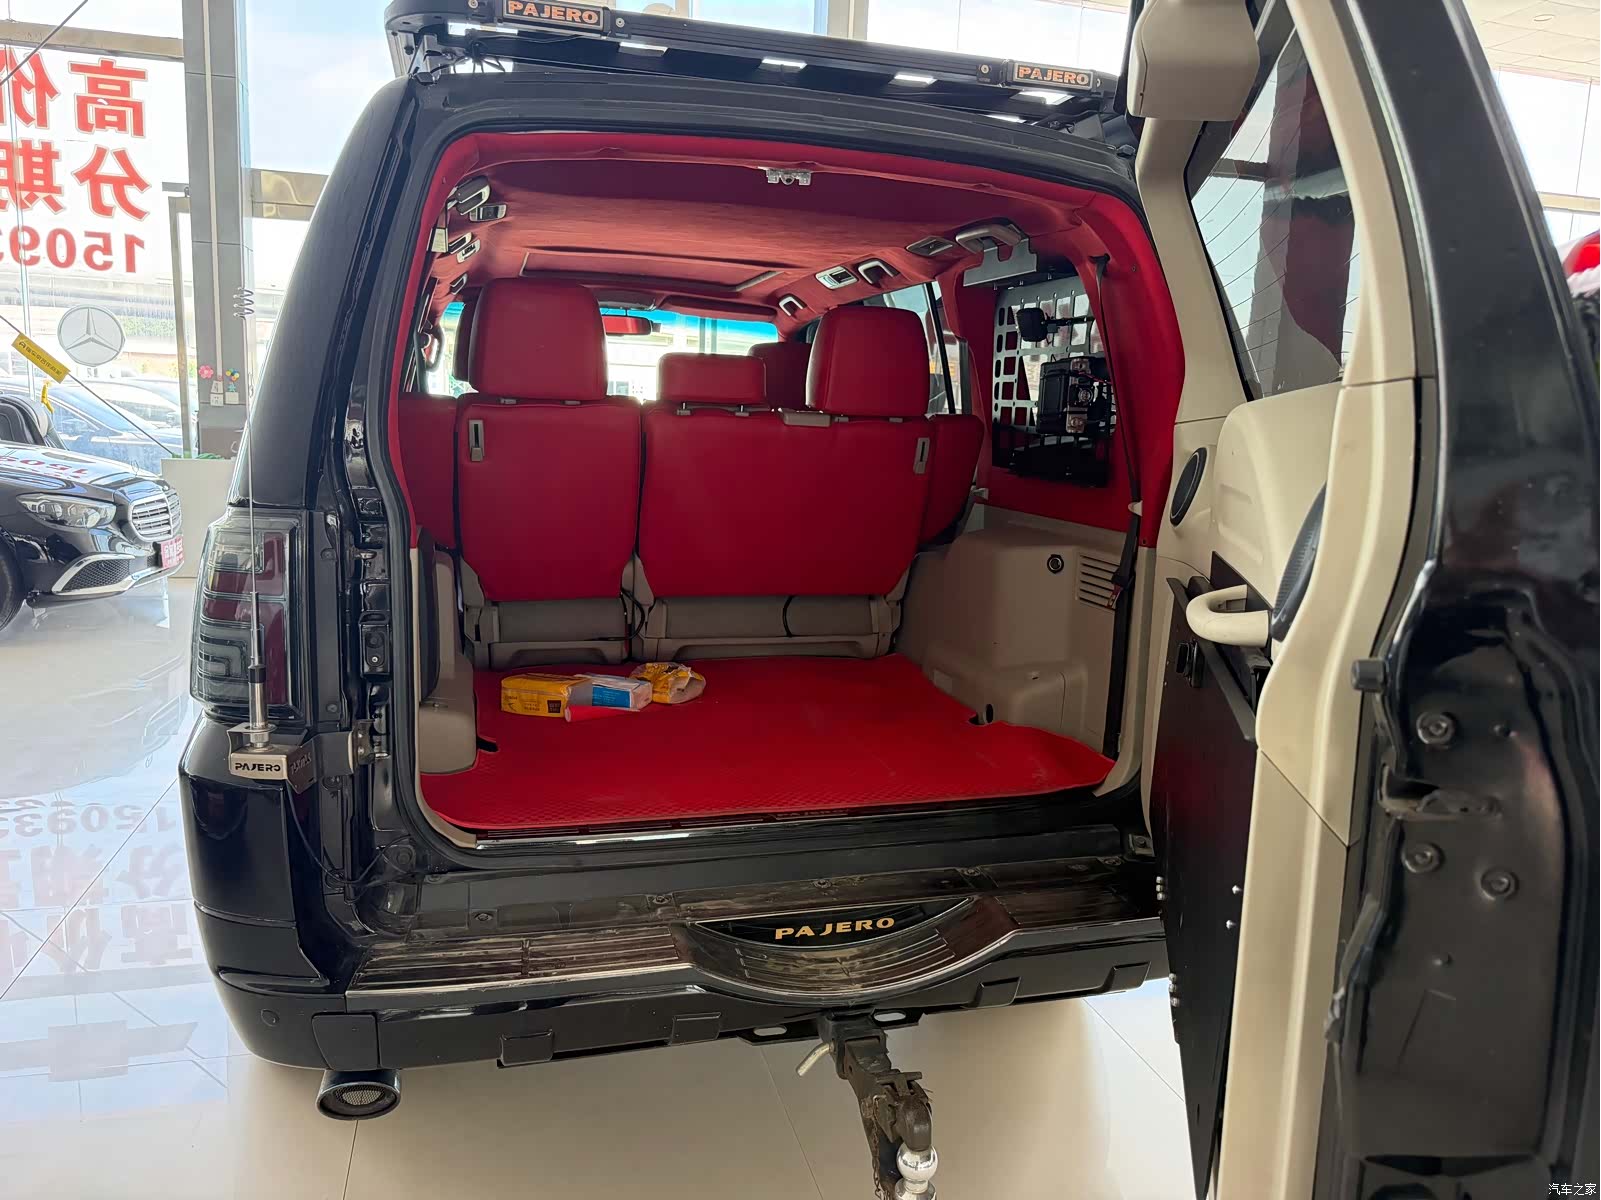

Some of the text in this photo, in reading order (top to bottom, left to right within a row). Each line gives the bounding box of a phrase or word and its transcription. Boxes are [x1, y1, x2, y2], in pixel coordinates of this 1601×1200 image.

[508, 1, 599, 24] PAJERO
[1019, 66, 1089, 85] PAJERO
[235, 762, 281, 772] PAJERO
[775, 917, 895, 940] PAJERO
